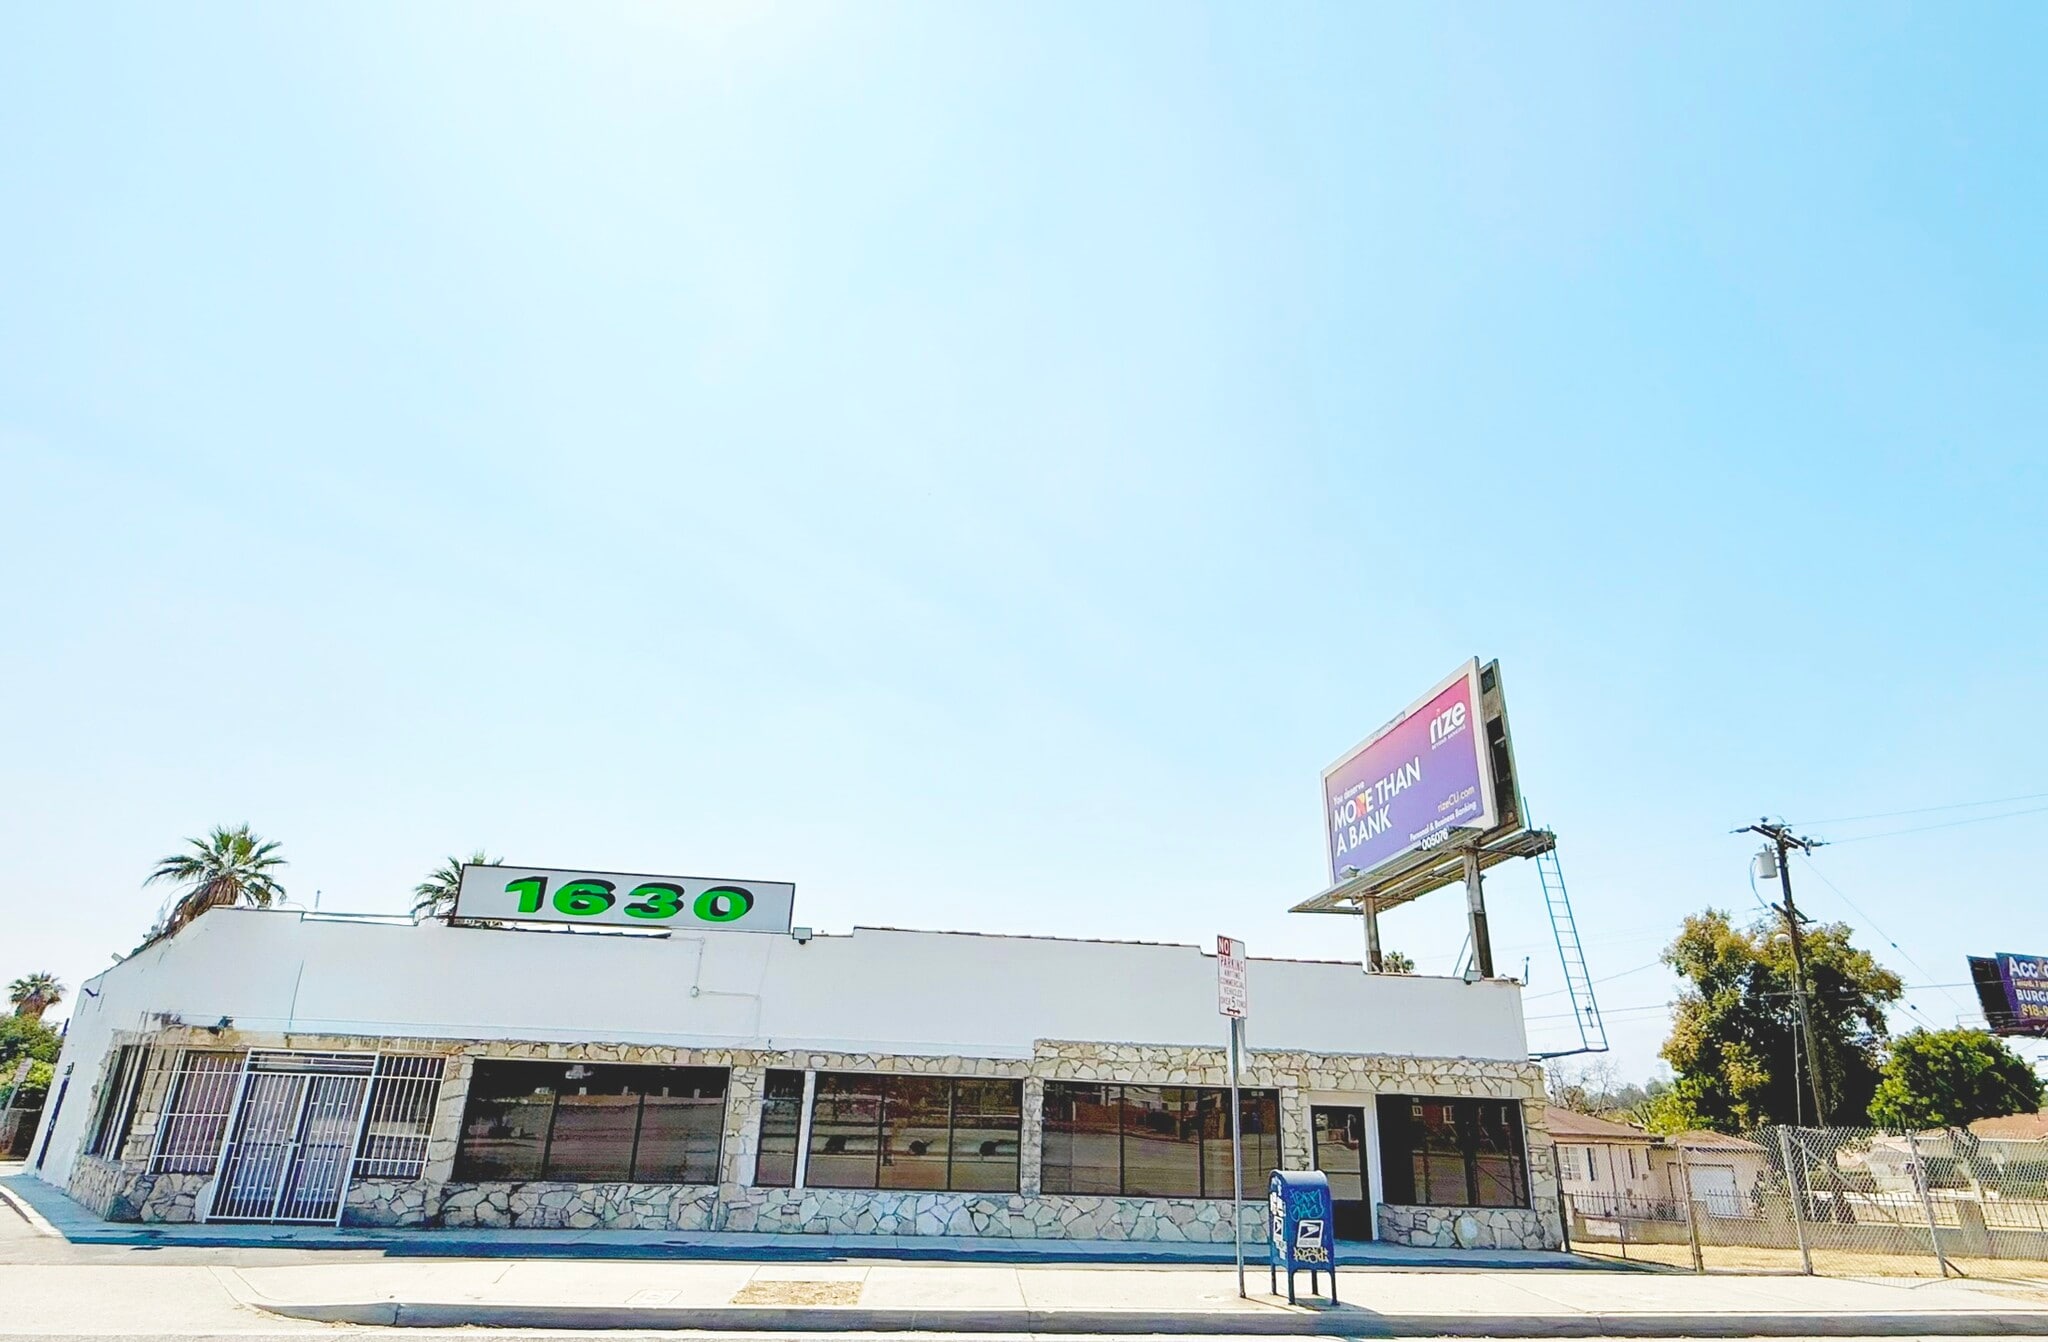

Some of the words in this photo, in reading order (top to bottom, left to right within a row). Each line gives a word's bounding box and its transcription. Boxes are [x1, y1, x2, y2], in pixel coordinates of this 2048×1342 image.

[1430, 701, 1466, 744] rize
[1375, 755, 1421, 806] THAN
[1336, 832, 1348, 857] A
[1348, 803, 1393, 850] BANK
[505, 876, 754, 922] 1630
[1218, 937, 1230, 955] NO
[1220, 955, 1244, 972] PARKING
[1231, 996, 1236, 1008] 5
[2015, 988, 2048, 1004] BURG
